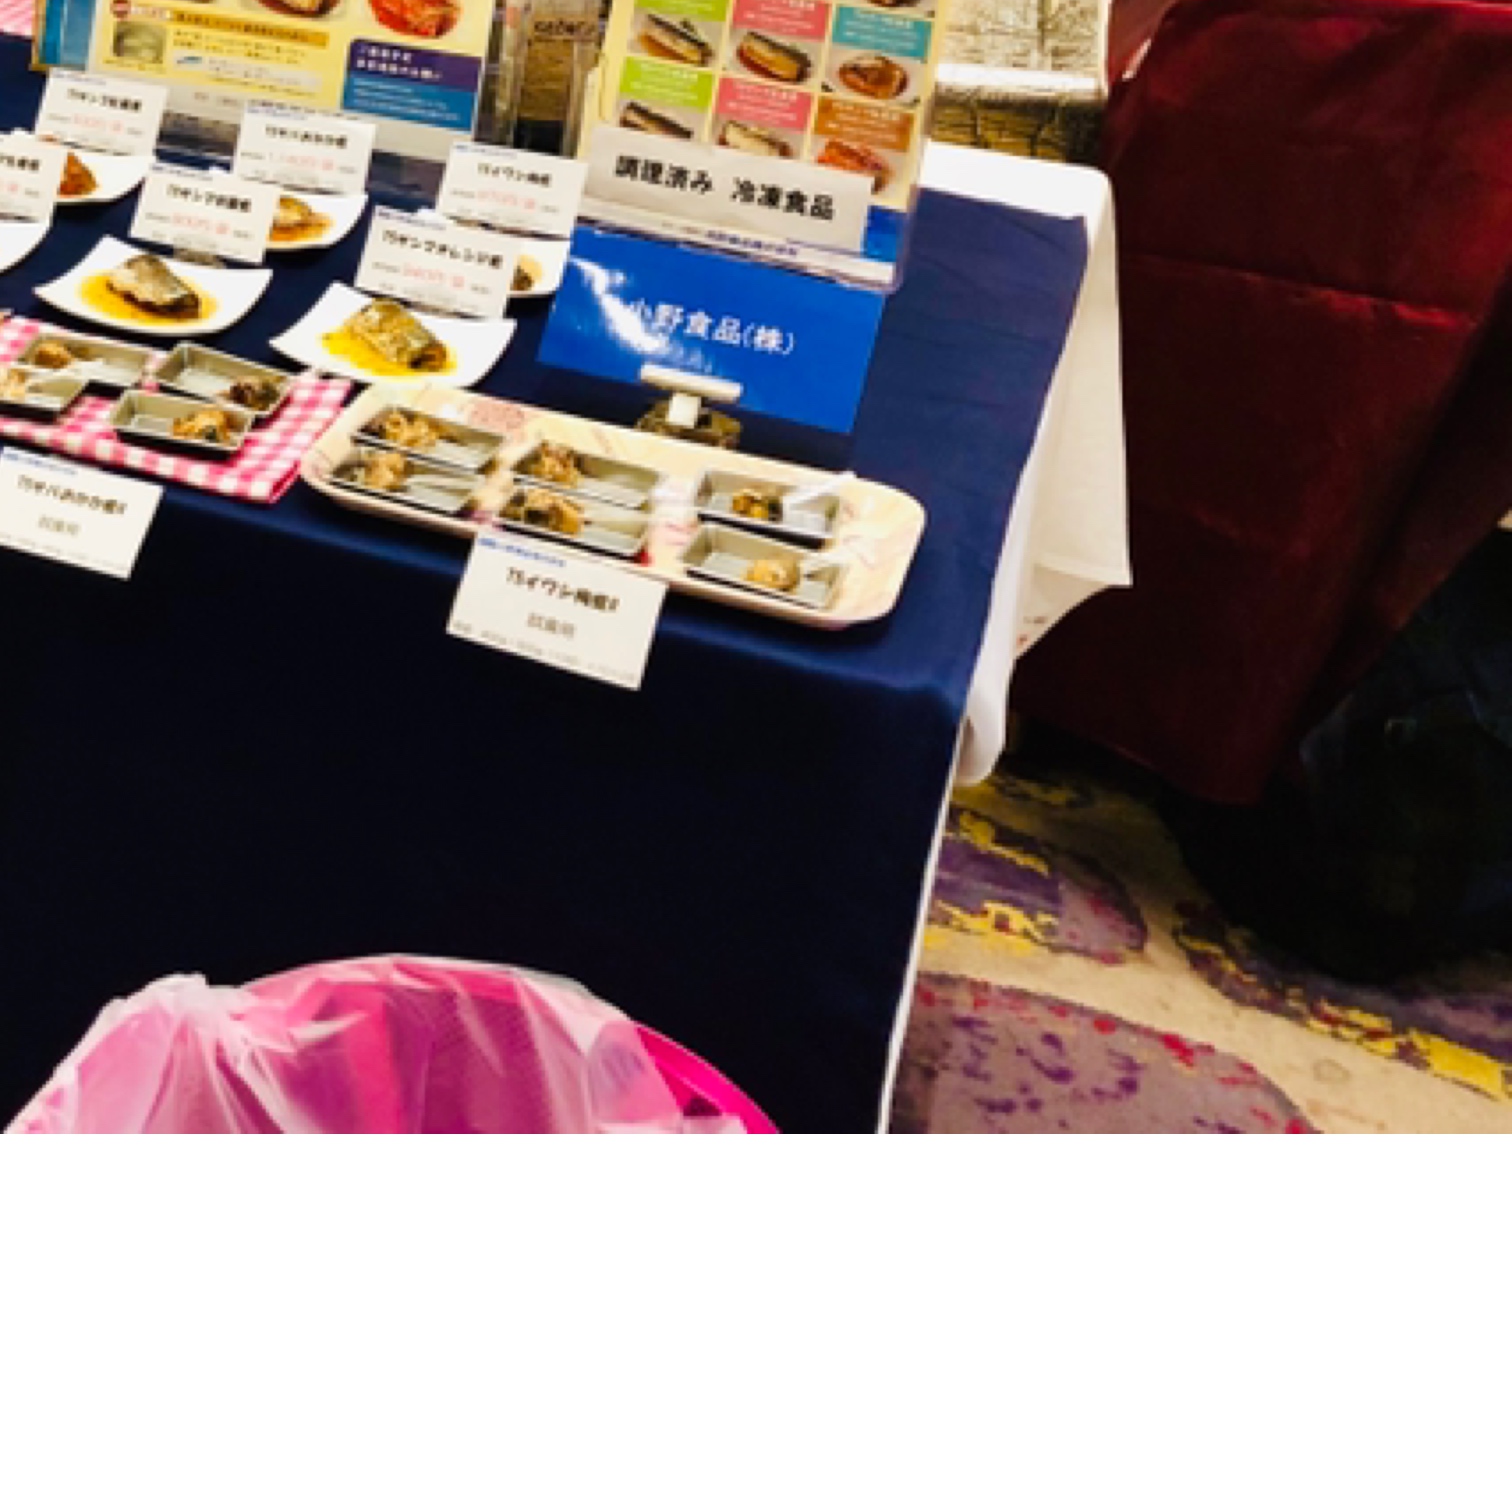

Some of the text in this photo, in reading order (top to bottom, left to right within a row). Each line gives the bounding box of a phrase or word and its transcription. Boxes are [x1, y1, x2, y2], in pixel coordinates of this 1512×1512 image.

[614, 154, 835, 221] 調理済み 冷凍食品
